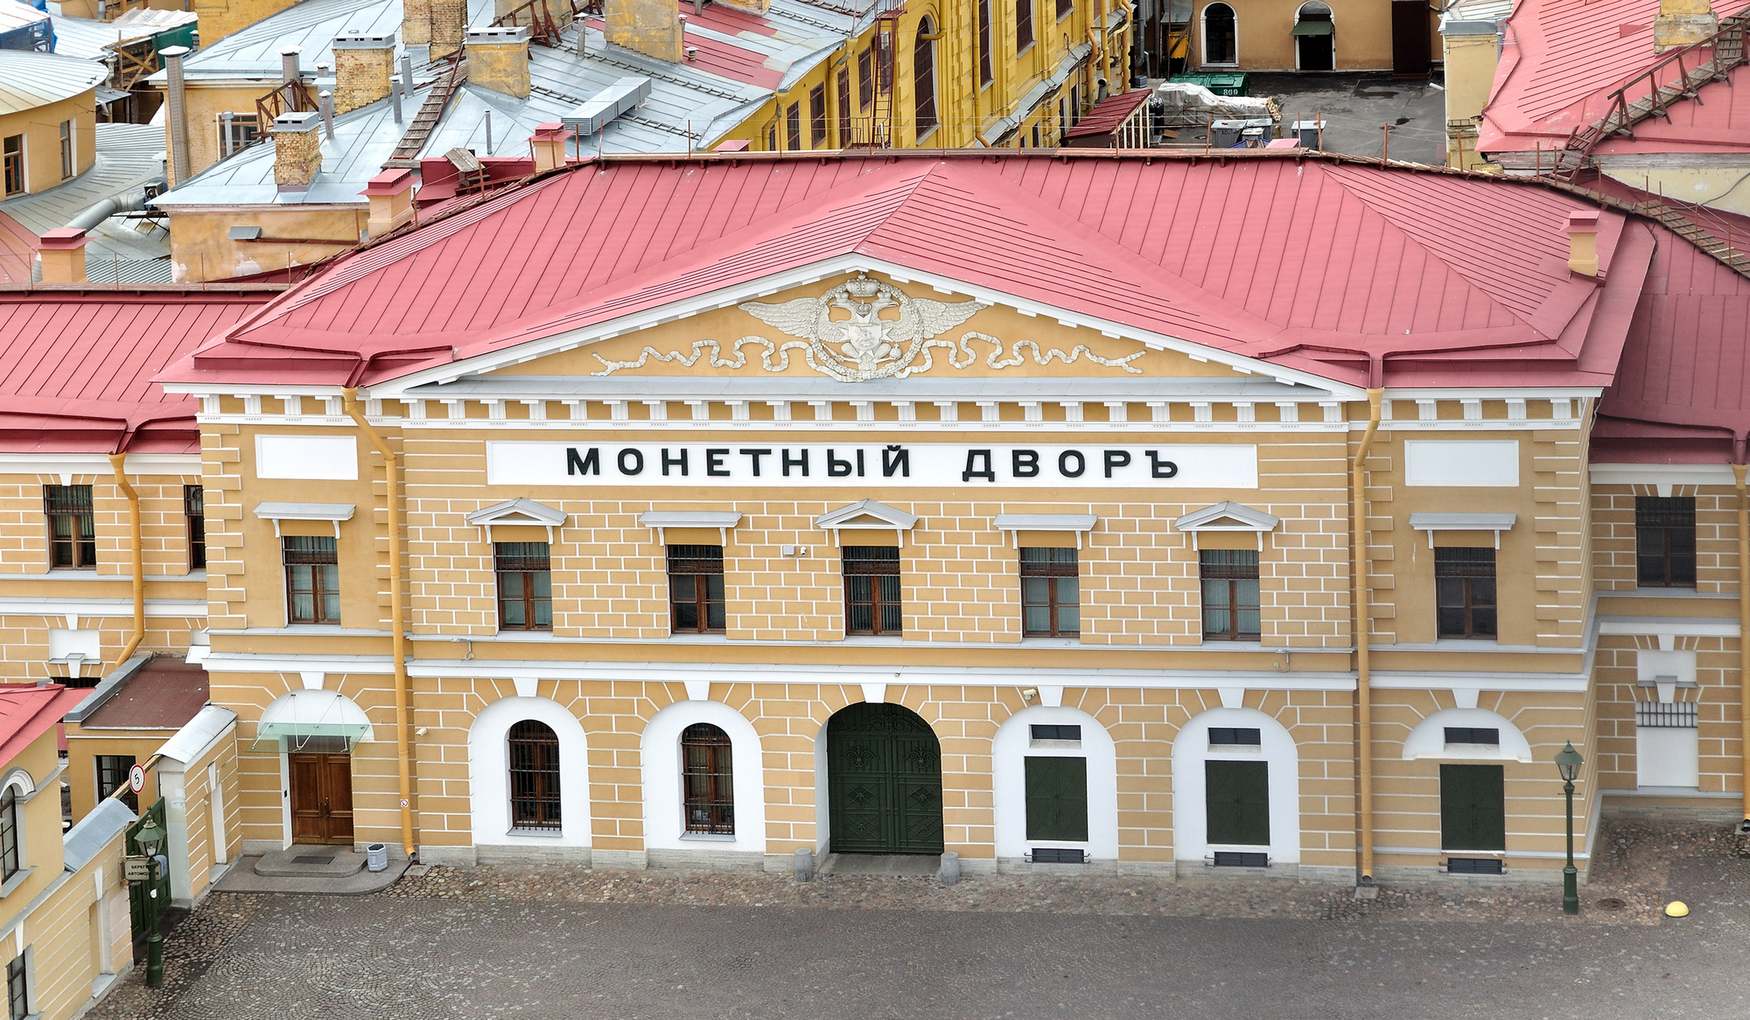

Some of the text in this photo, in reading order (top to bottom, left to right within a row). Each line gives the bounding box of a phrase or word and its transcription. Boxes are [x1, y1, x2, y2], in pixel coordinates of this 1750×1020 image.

[566, 444, 1178, 482] МОНЕТНЫЙ ДВОРЪ
[134, 773, 140, 785] 5
